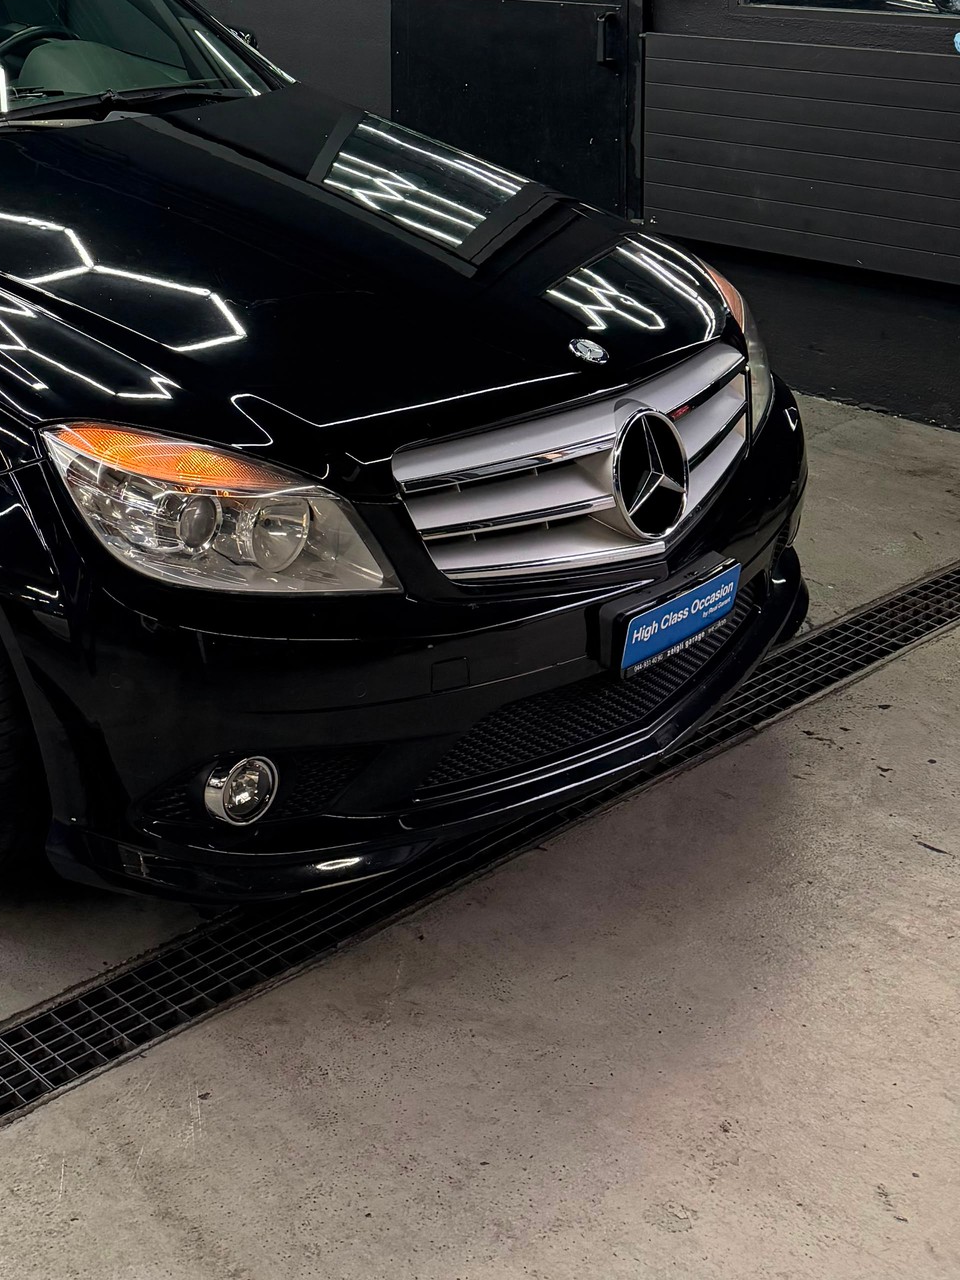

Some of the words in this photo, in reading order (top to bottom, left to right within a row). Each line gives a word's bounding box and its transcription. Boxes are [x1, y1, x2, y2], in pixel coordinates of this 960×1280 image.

[632, 620, 659, 644] High
[661, 607, 689, 630] Class
[691, 581, 734, 614] Occasion
[685, 631, 705, 649] garage
